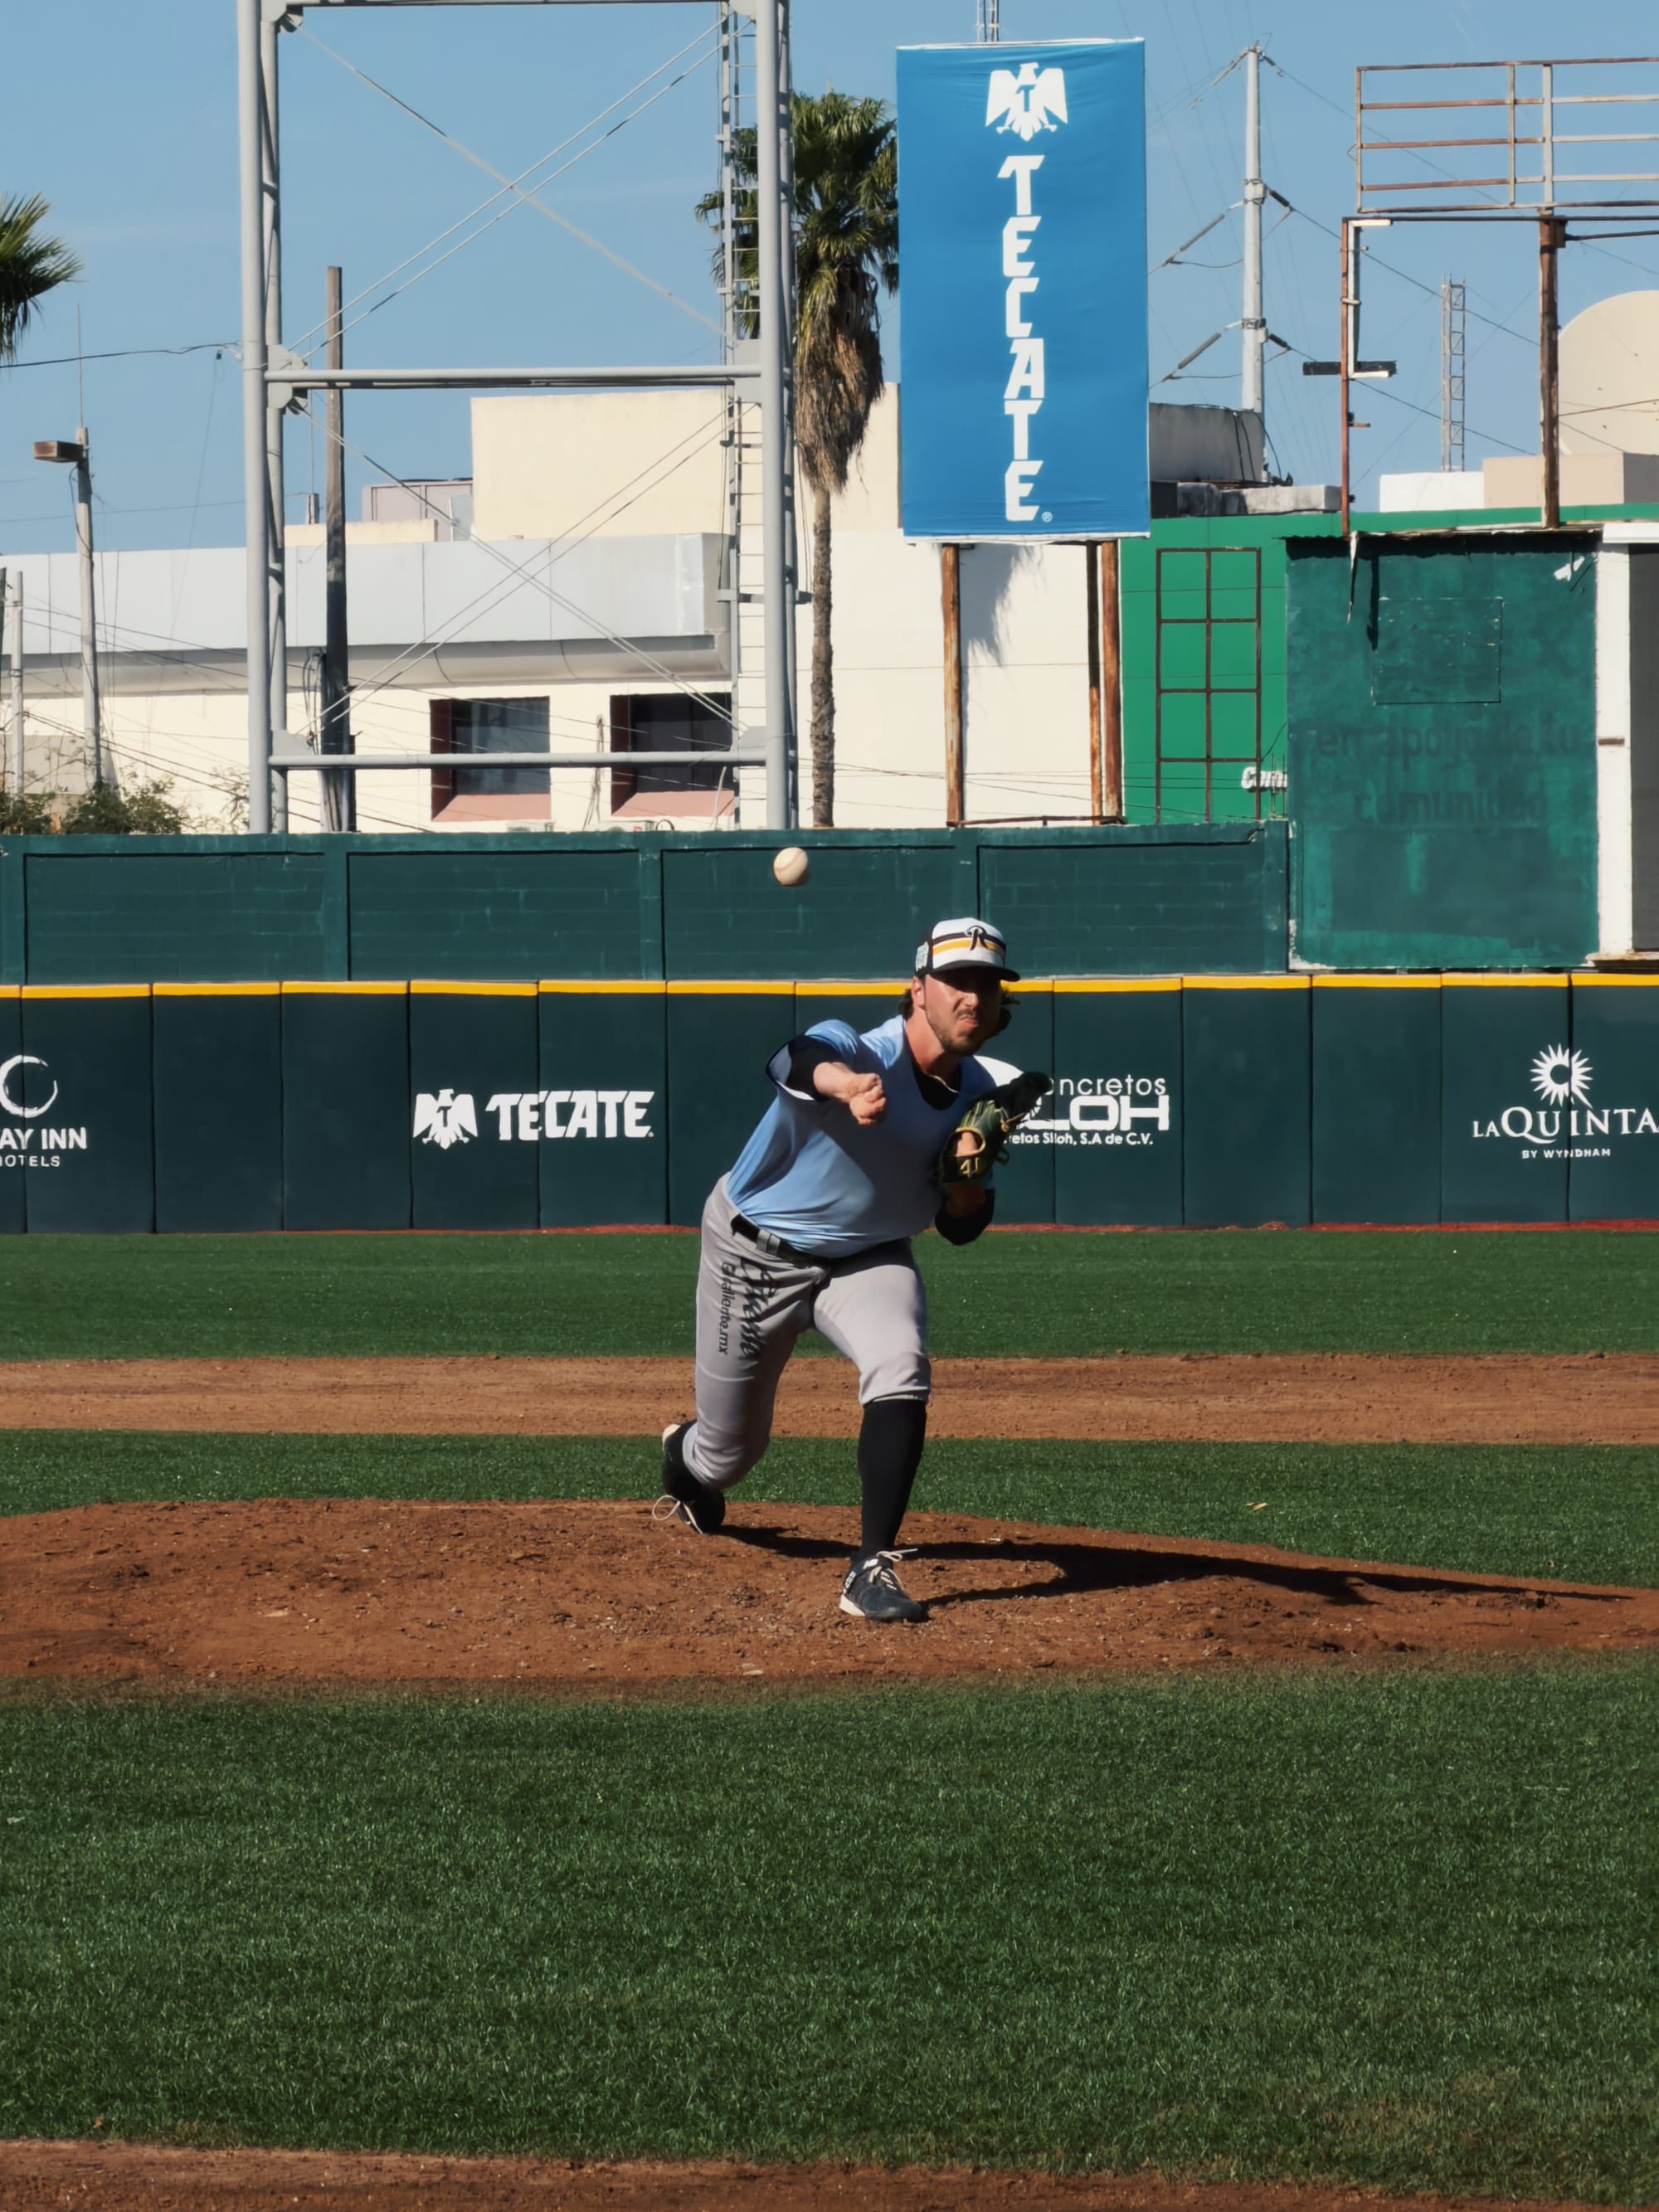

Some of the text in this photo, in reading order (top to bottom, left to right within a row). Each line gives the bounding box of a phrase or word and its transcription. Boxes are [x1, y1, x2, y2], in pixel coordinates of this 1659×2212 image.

[997, 154, 1046, 522] TECATE
[1044, 1074, 1167, 1096] ncretos
[485, 1090, 655, 1141] TECATE
[1501, 1106, 1659, 1144] QUINTA
[41, 1127, 87, 1150] INN
[1105, 1133, 1123, 1145] de
[1126, 1132, 1154, 1145] C.V.
[1522, 1148, 1612, 1159] BY WYNDHAM
